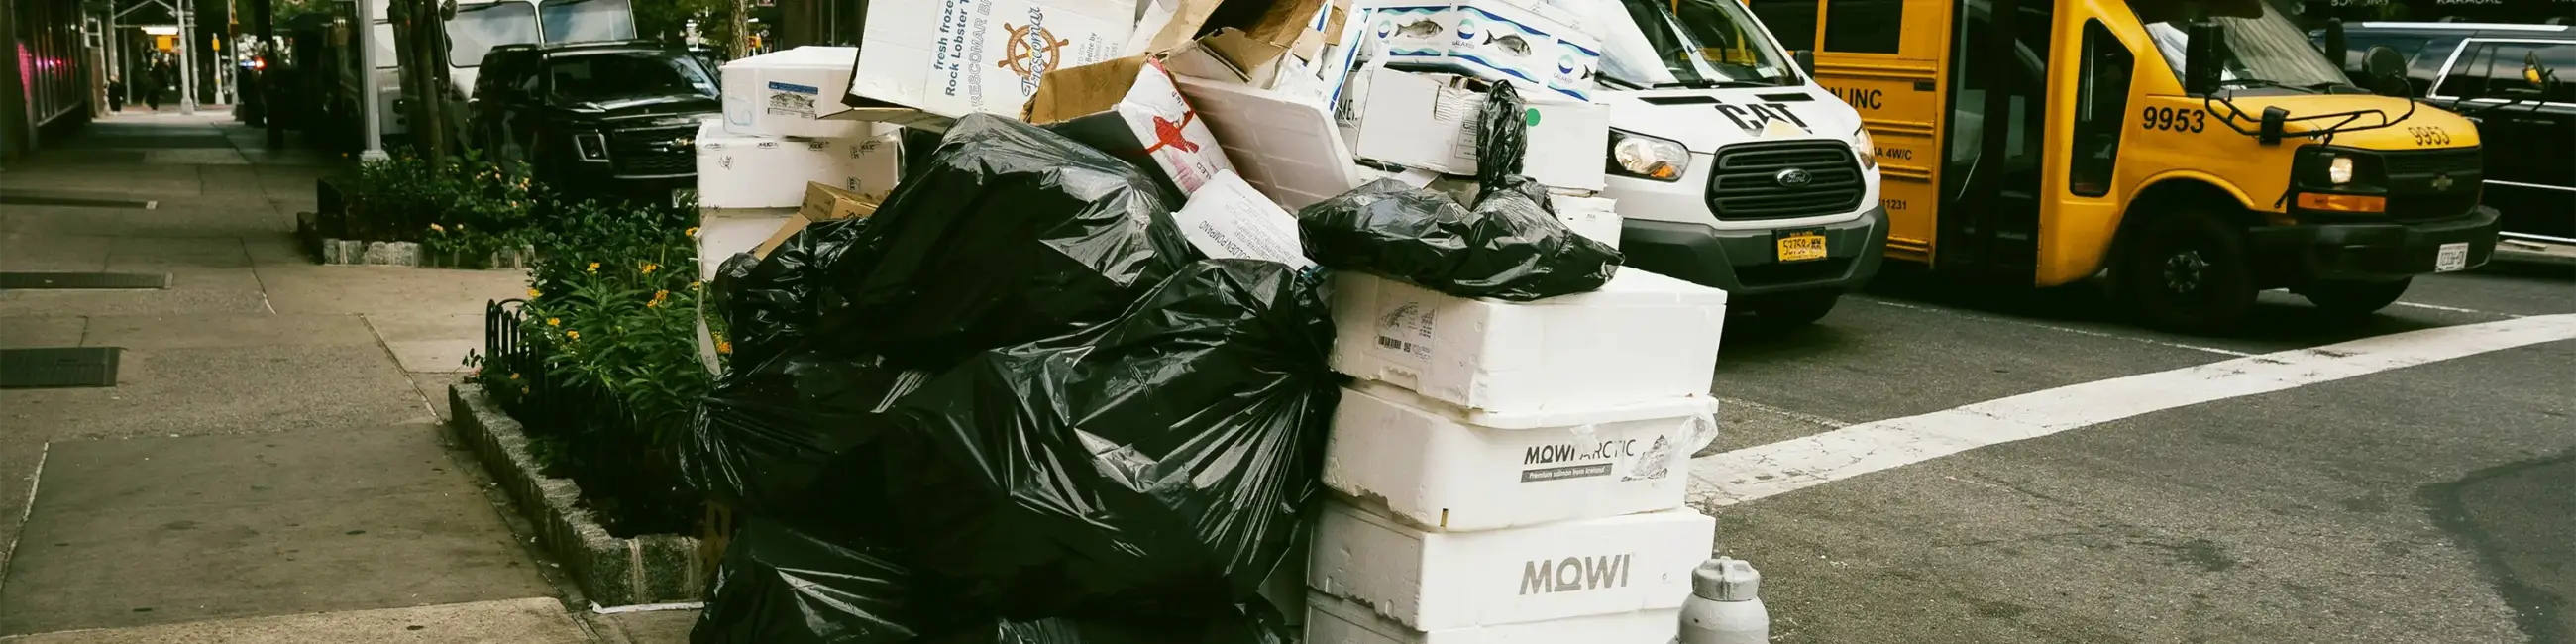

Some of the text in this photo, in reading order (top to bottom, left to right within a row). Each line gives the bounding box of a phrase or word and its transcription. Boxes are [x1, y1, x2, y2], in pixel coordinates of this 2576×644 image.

[934, 0, 953, 70] fresh froze
[951, 8, 967, 59] Lobster
[1084, 32, 1096, 62] Belize by
[1021, 7, 1043, 97] Frescomar
[945, 63, 959, 96] Rock
[1848, 88, 1882, 110] INC
[1714, 103, 1813, 137] CAT
[2142, 105, 2205, 134] 9953
[2408, 127, 2450, 146] 9953
[1786, 172, 1806, 184] Ford
[1198, 220, 1229, 248] POMPANO
[1524, 444, 1575, 465] MOWI
[1519, 554, 1630, 595] MOWI
